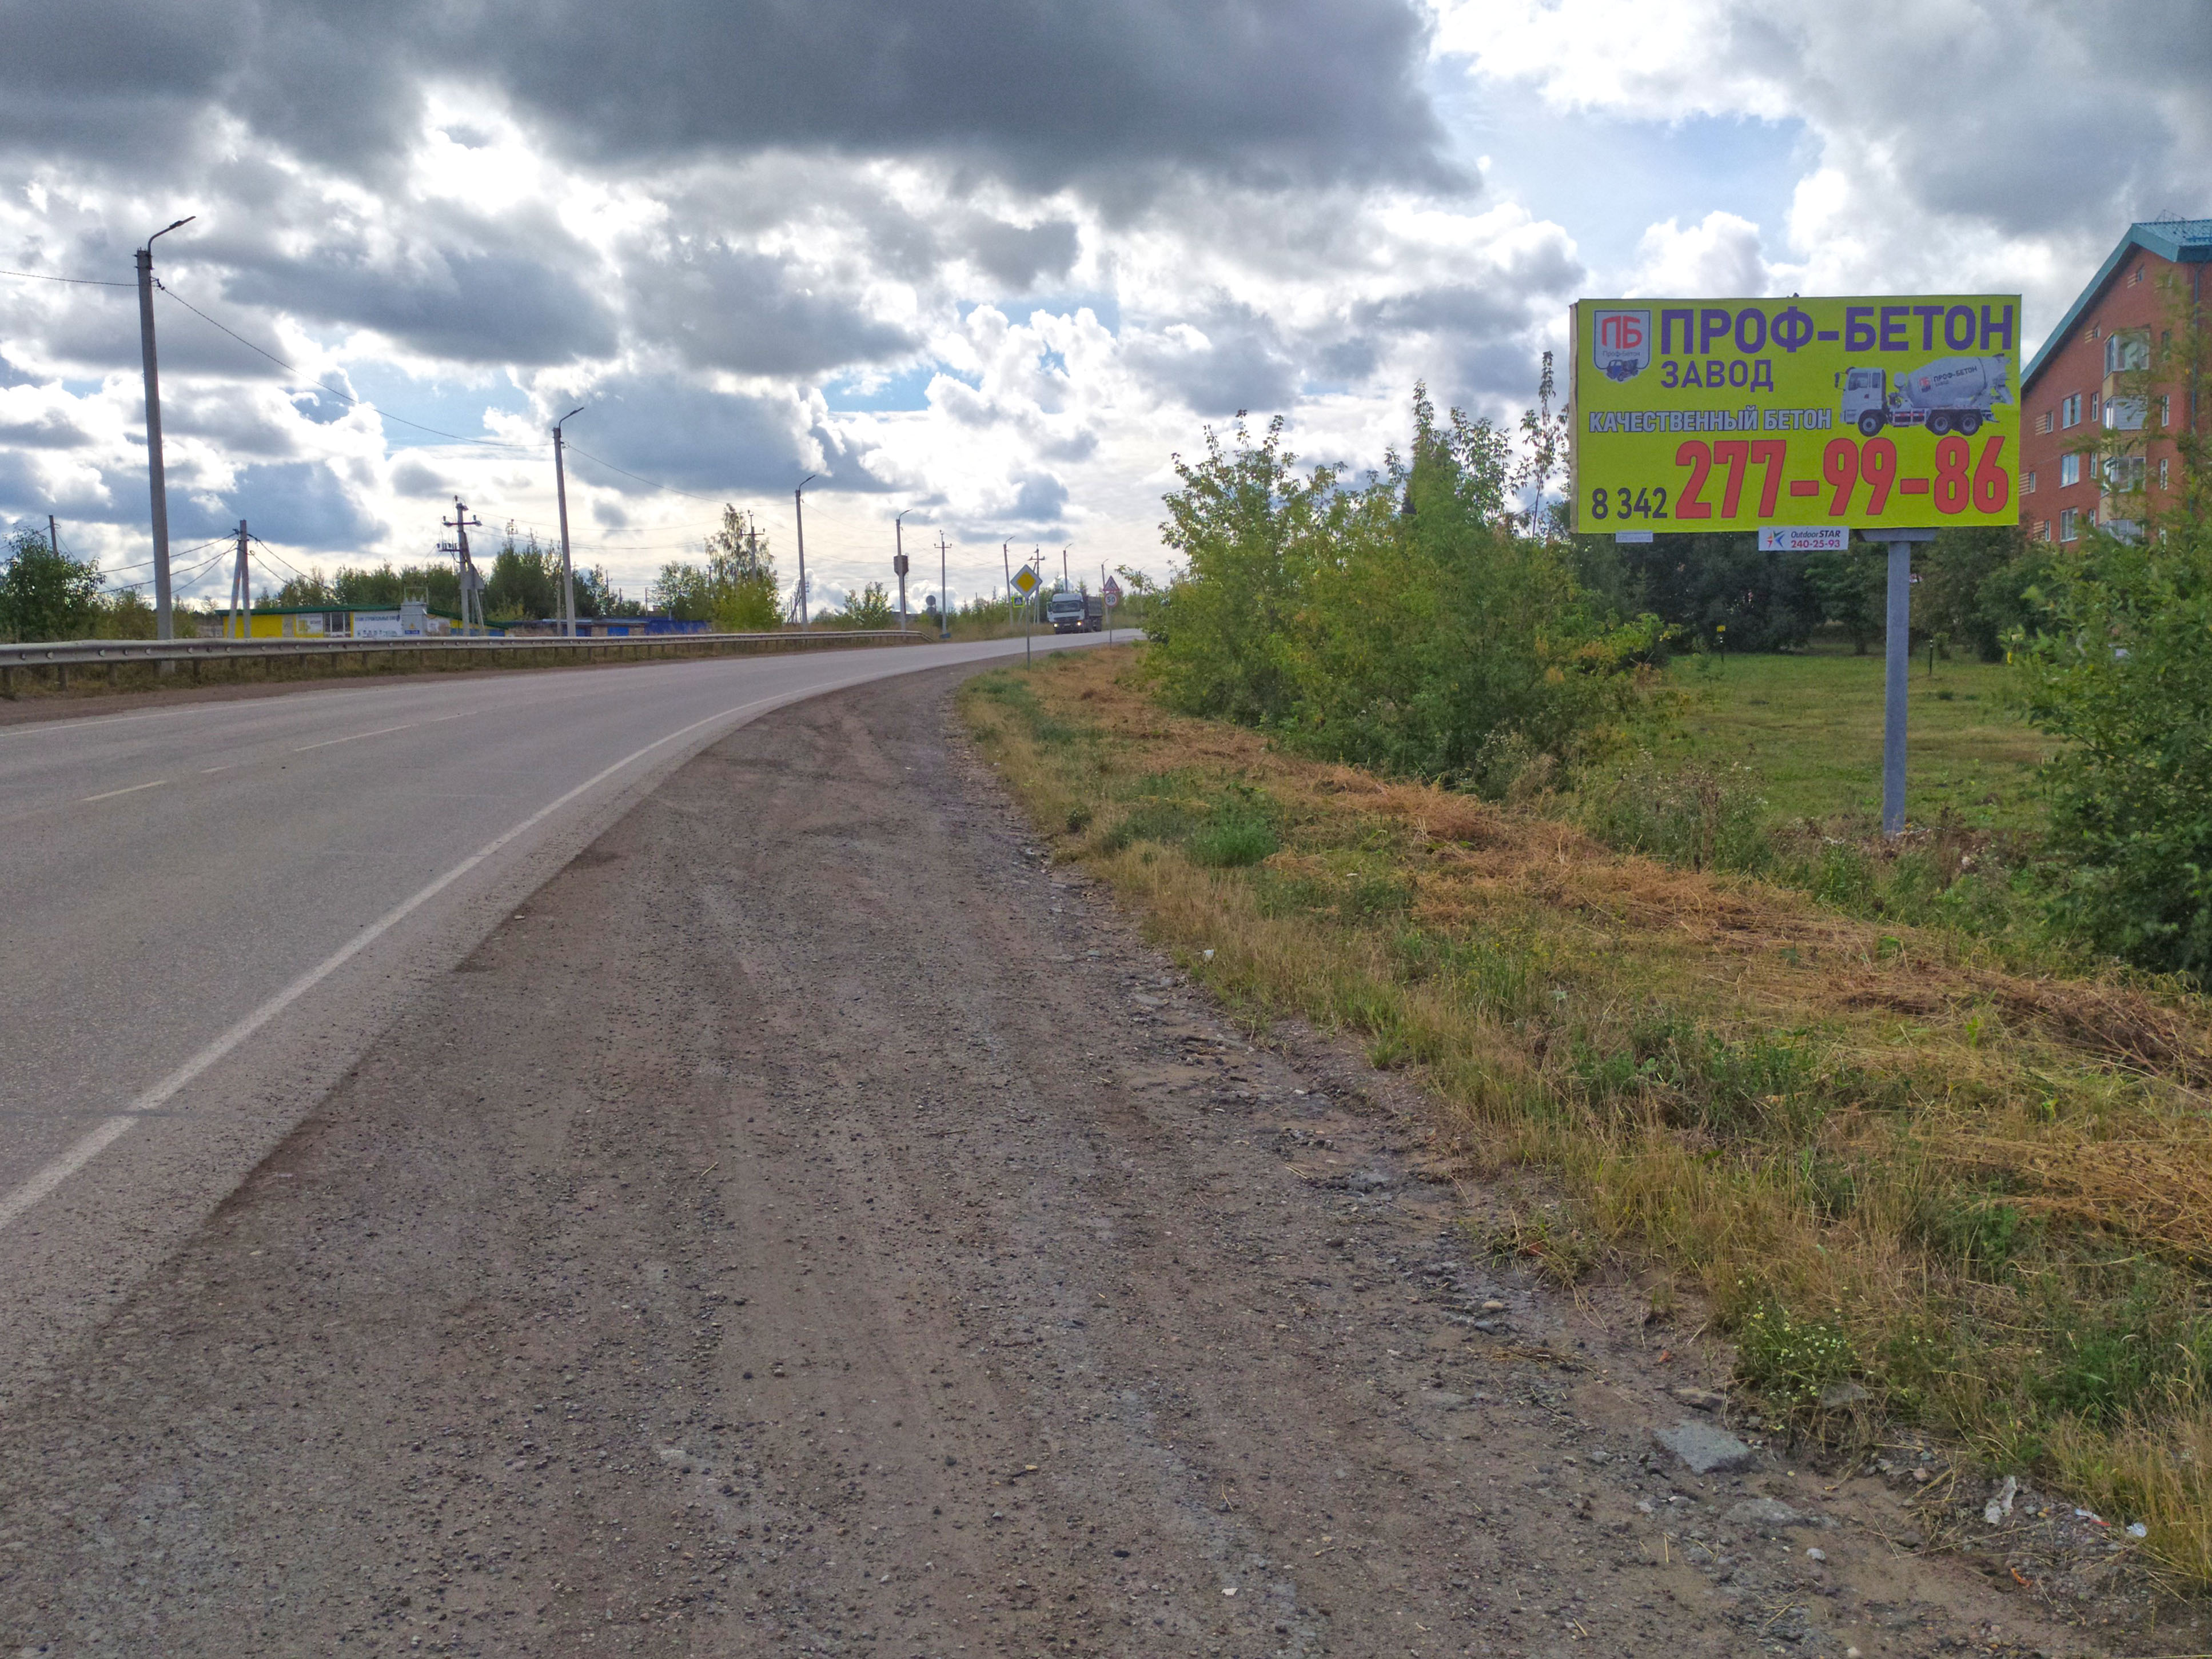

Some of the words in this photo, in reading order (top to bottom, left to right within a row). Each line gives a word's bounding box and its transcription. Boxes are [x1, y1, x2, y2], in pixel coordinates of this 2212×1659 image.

[1601, 315, 1642, 350] ПБ
[1661, 305, 2013, 355] ПРОФ-БЕТОН
[1660, 359, 1773, 393] ЗАВОД
[1933, 365, 1978, 382] ПРОФ-БЕТОН
[1589, 405, 1759, 433] КАЧЕСТВЕННЫЙ
[1763, 408, 1832, 430] БЕТОН
[1591, 488, 1608, 520] 8
[1616, 486, 1668, 520] 342
[1675, 436, 2010, 519] 277-99-86
[1791, 539, 1840, 548] 240-25-93
